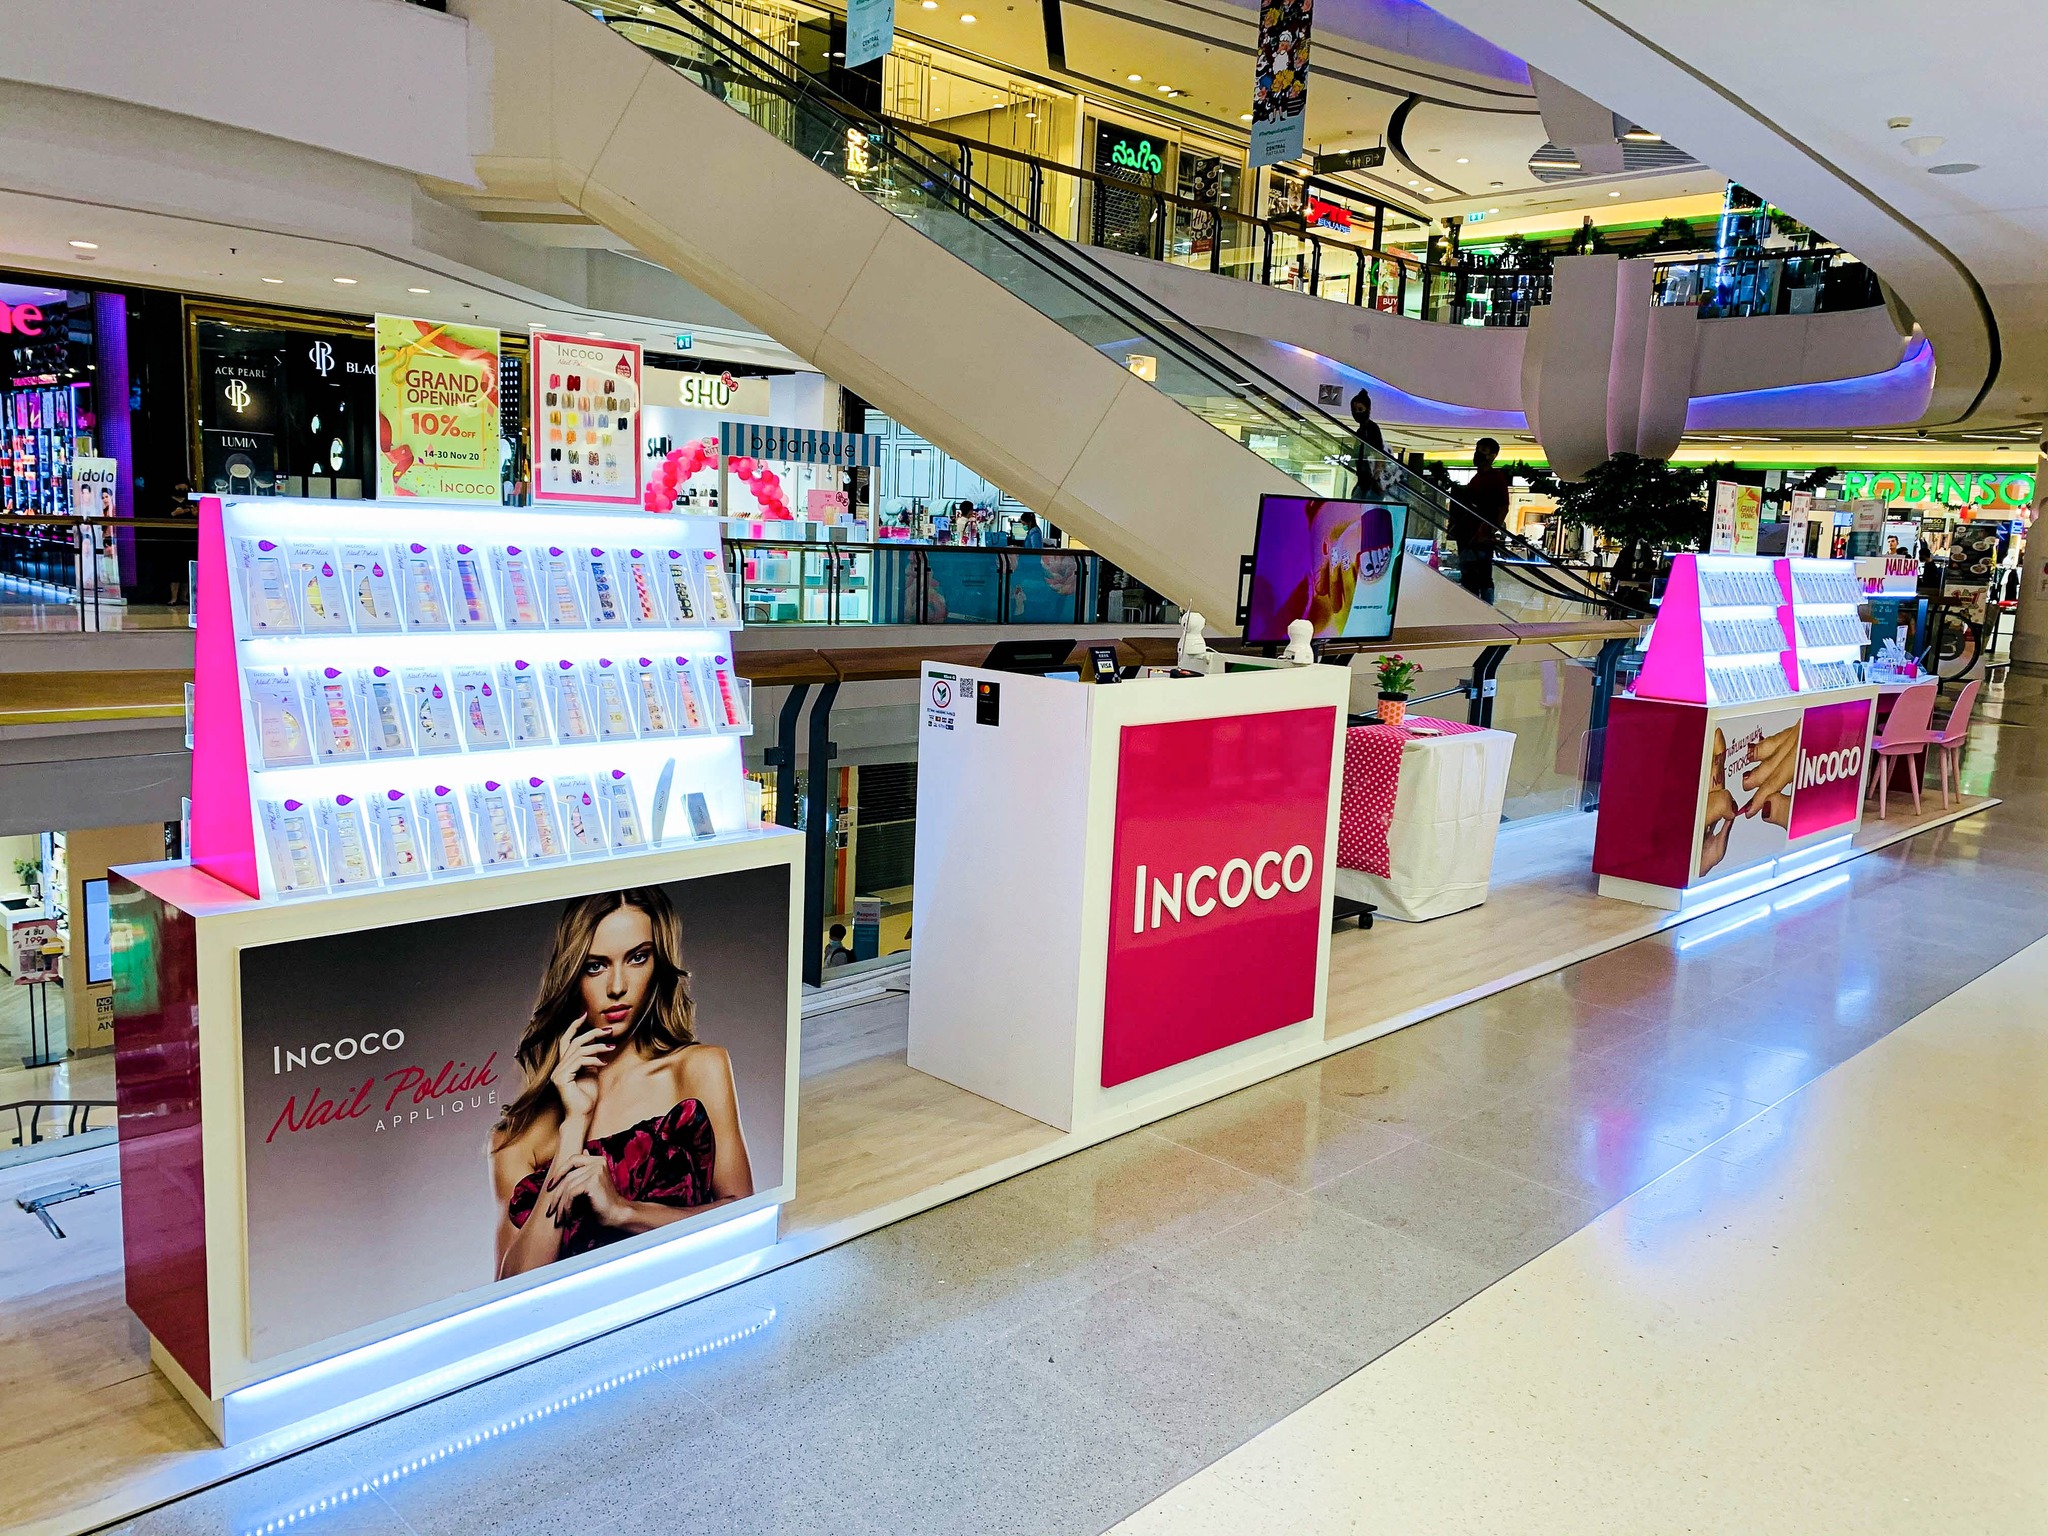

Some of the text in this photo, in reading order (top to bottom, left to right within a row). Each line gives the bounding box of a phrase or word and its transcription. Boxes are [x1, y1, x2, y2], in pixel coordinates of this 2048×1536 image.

[1382, 297, 1398, 306] BUY
[557, 344, 604, 361] INCOCO
[237, 367, 268, 379] PEARL
[405, 369, 479, 394] GRAND
[406, 388, 478, 408] OPENING
[682, 376, 731, 408] SHU
[411, 412, 476, 439] 10% OFF
[221, 435, 258, 449] LUMIA
[423, 449, 480, 460] 14-30 Nov 20
[751, 432, 856, 459] botanique
[439, 479, 496, 495] INCOCO
[1843, 471, 2037, 506] ROBINSO
[1796, 746, 1861, 790] INCOCO
[1133, 844, 1314, 934] INCOCO
[273, 1028, 406, 1075] INCOCO
[265, 1050, 499, 1144] Nail Polish
